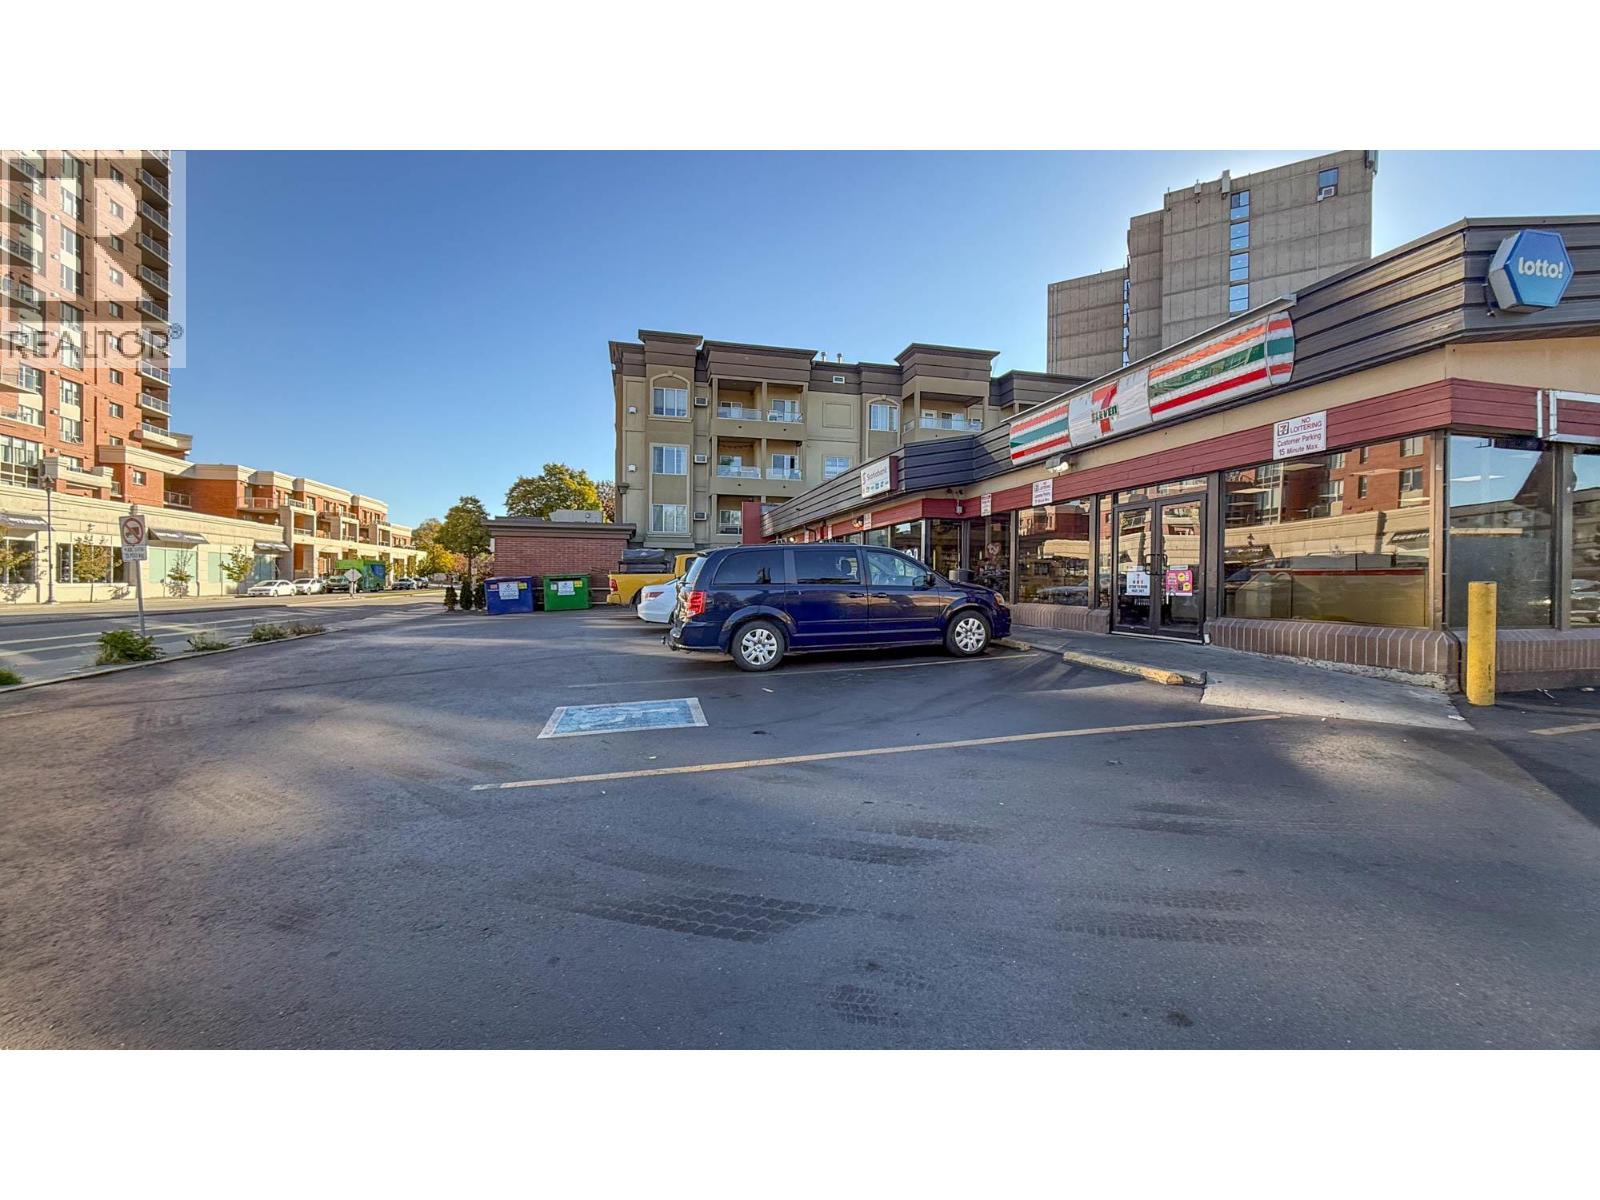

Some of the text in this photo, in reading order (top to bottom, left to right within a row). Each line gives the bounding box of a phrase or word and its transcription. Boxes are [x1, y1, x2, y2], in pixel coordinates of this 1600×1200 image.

[1518, 257, 1564, 279] lotto!
[1290, 420, 1322, 433] LOITERING
[1301, 416, 1311, 424] NO
[1277, 433, 1321, 447] Customer Parking
[1279, 448, 1285, 456] 15
[1287, 446, 1304, 454] Minute
